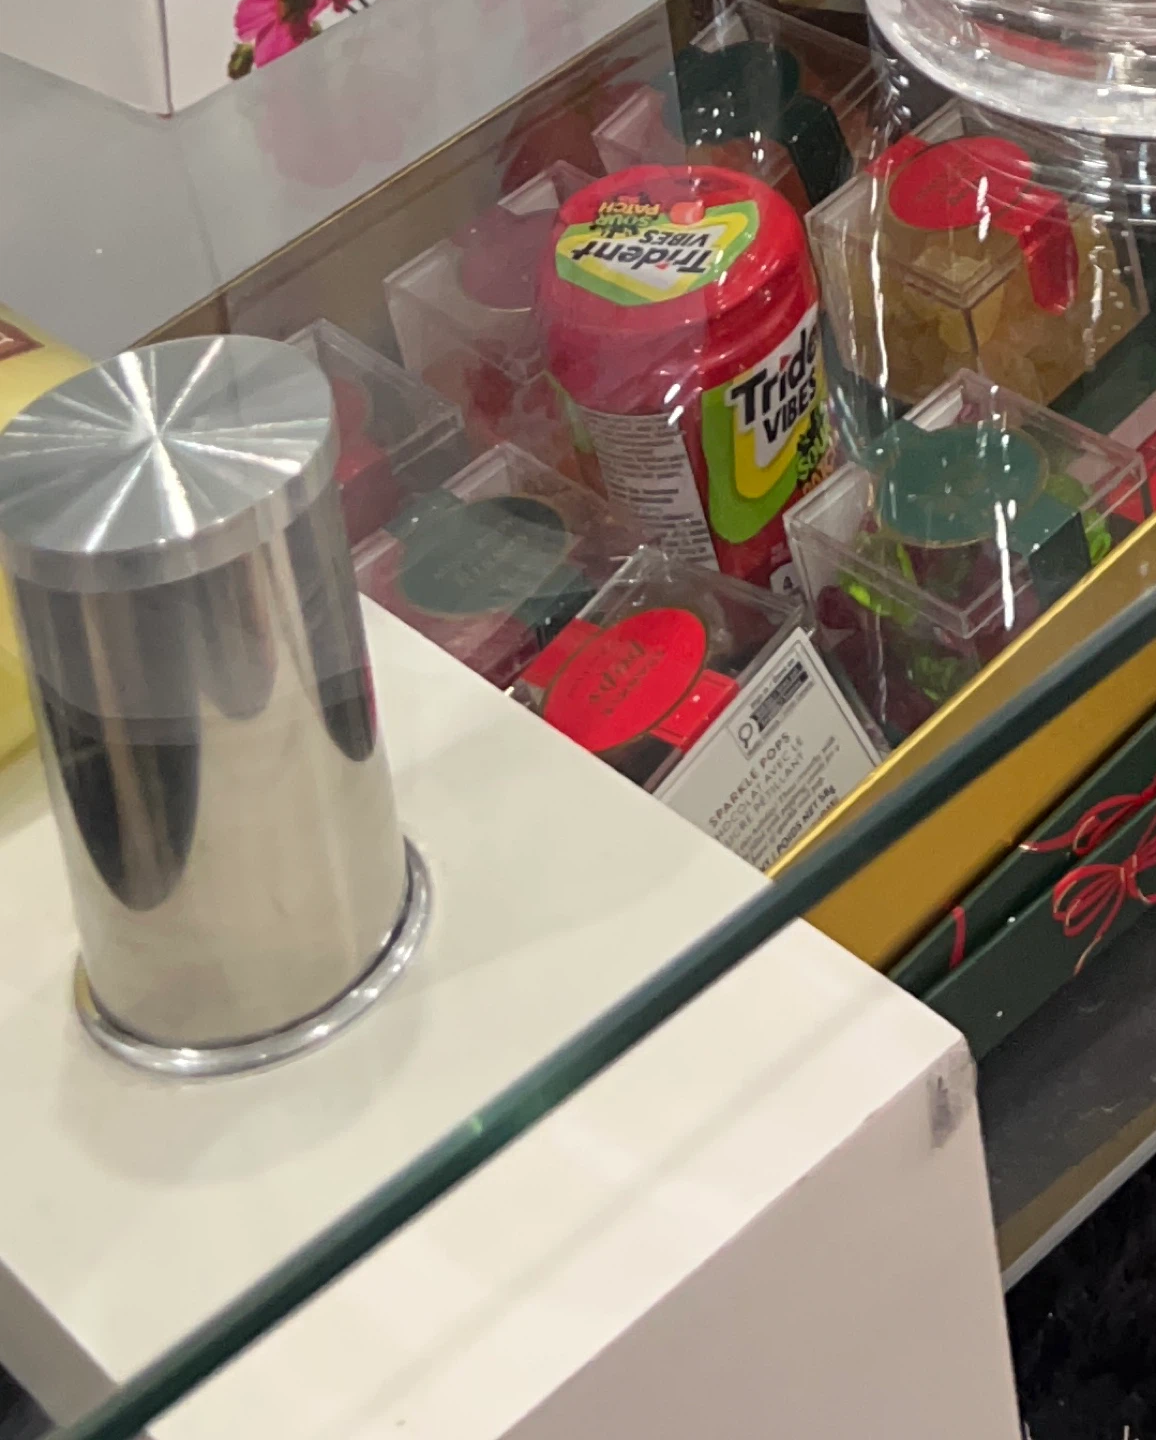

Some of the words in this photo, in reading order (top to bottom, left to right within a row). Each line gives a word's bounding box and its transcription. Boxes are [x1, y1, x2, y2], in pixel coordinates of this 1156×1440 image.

[570, 240, 713, 274] Trident
[639, 228, 711, 248] VIBES
[708, 766, 759, 828] SPARKLE
[759, 731, 790, 769] POPS
[714, 781, 762, 841] HOCOLAT
